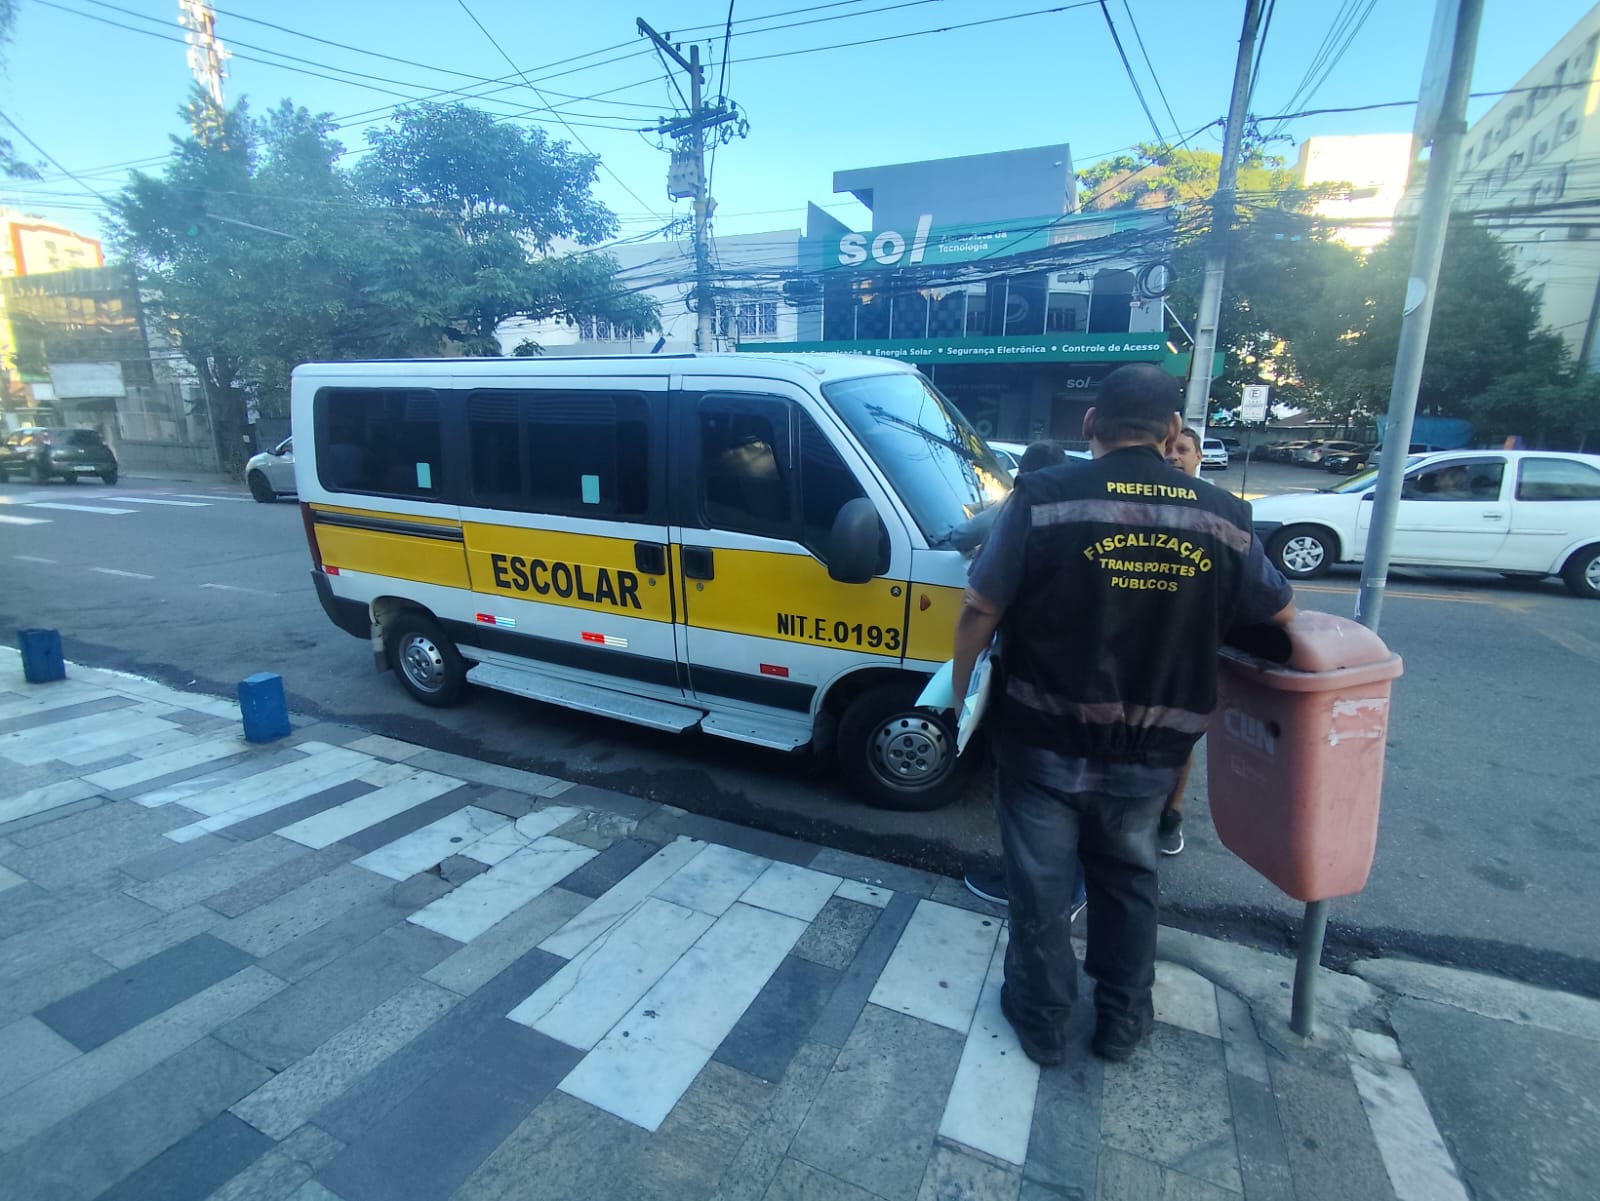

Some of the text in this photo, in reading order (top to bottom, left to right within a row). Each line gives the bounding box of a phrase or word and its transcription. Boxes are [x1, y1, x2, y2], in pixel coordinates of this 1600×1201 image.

[838, 214, 933, 266] sol
[938, 243, 989, 253] Tecnologia
[875, 348, 907, 357] Energia
[909, 347, 932, 356] Solar
[946, 347, 995, 357] Segurança
[997, 345, 1046, 354] Eletrônica
[1062, 343, 1105, 353] Controle
[1107, 343, 1121, 352] de
[1122, 342, 1160, 352] Acesso
[1066, 376, 1091, 389] sol
[1106, 481, 1198, 500] PREFEITURA
[1083, 533, 1212, 572] FISCALIZAÇÃO
[1099, 558, 1196, 577] TRANSPORTES
[491, 553, 642, 610] ESCOLAR
[777, 612, 901, 650] NIT.E.0193
